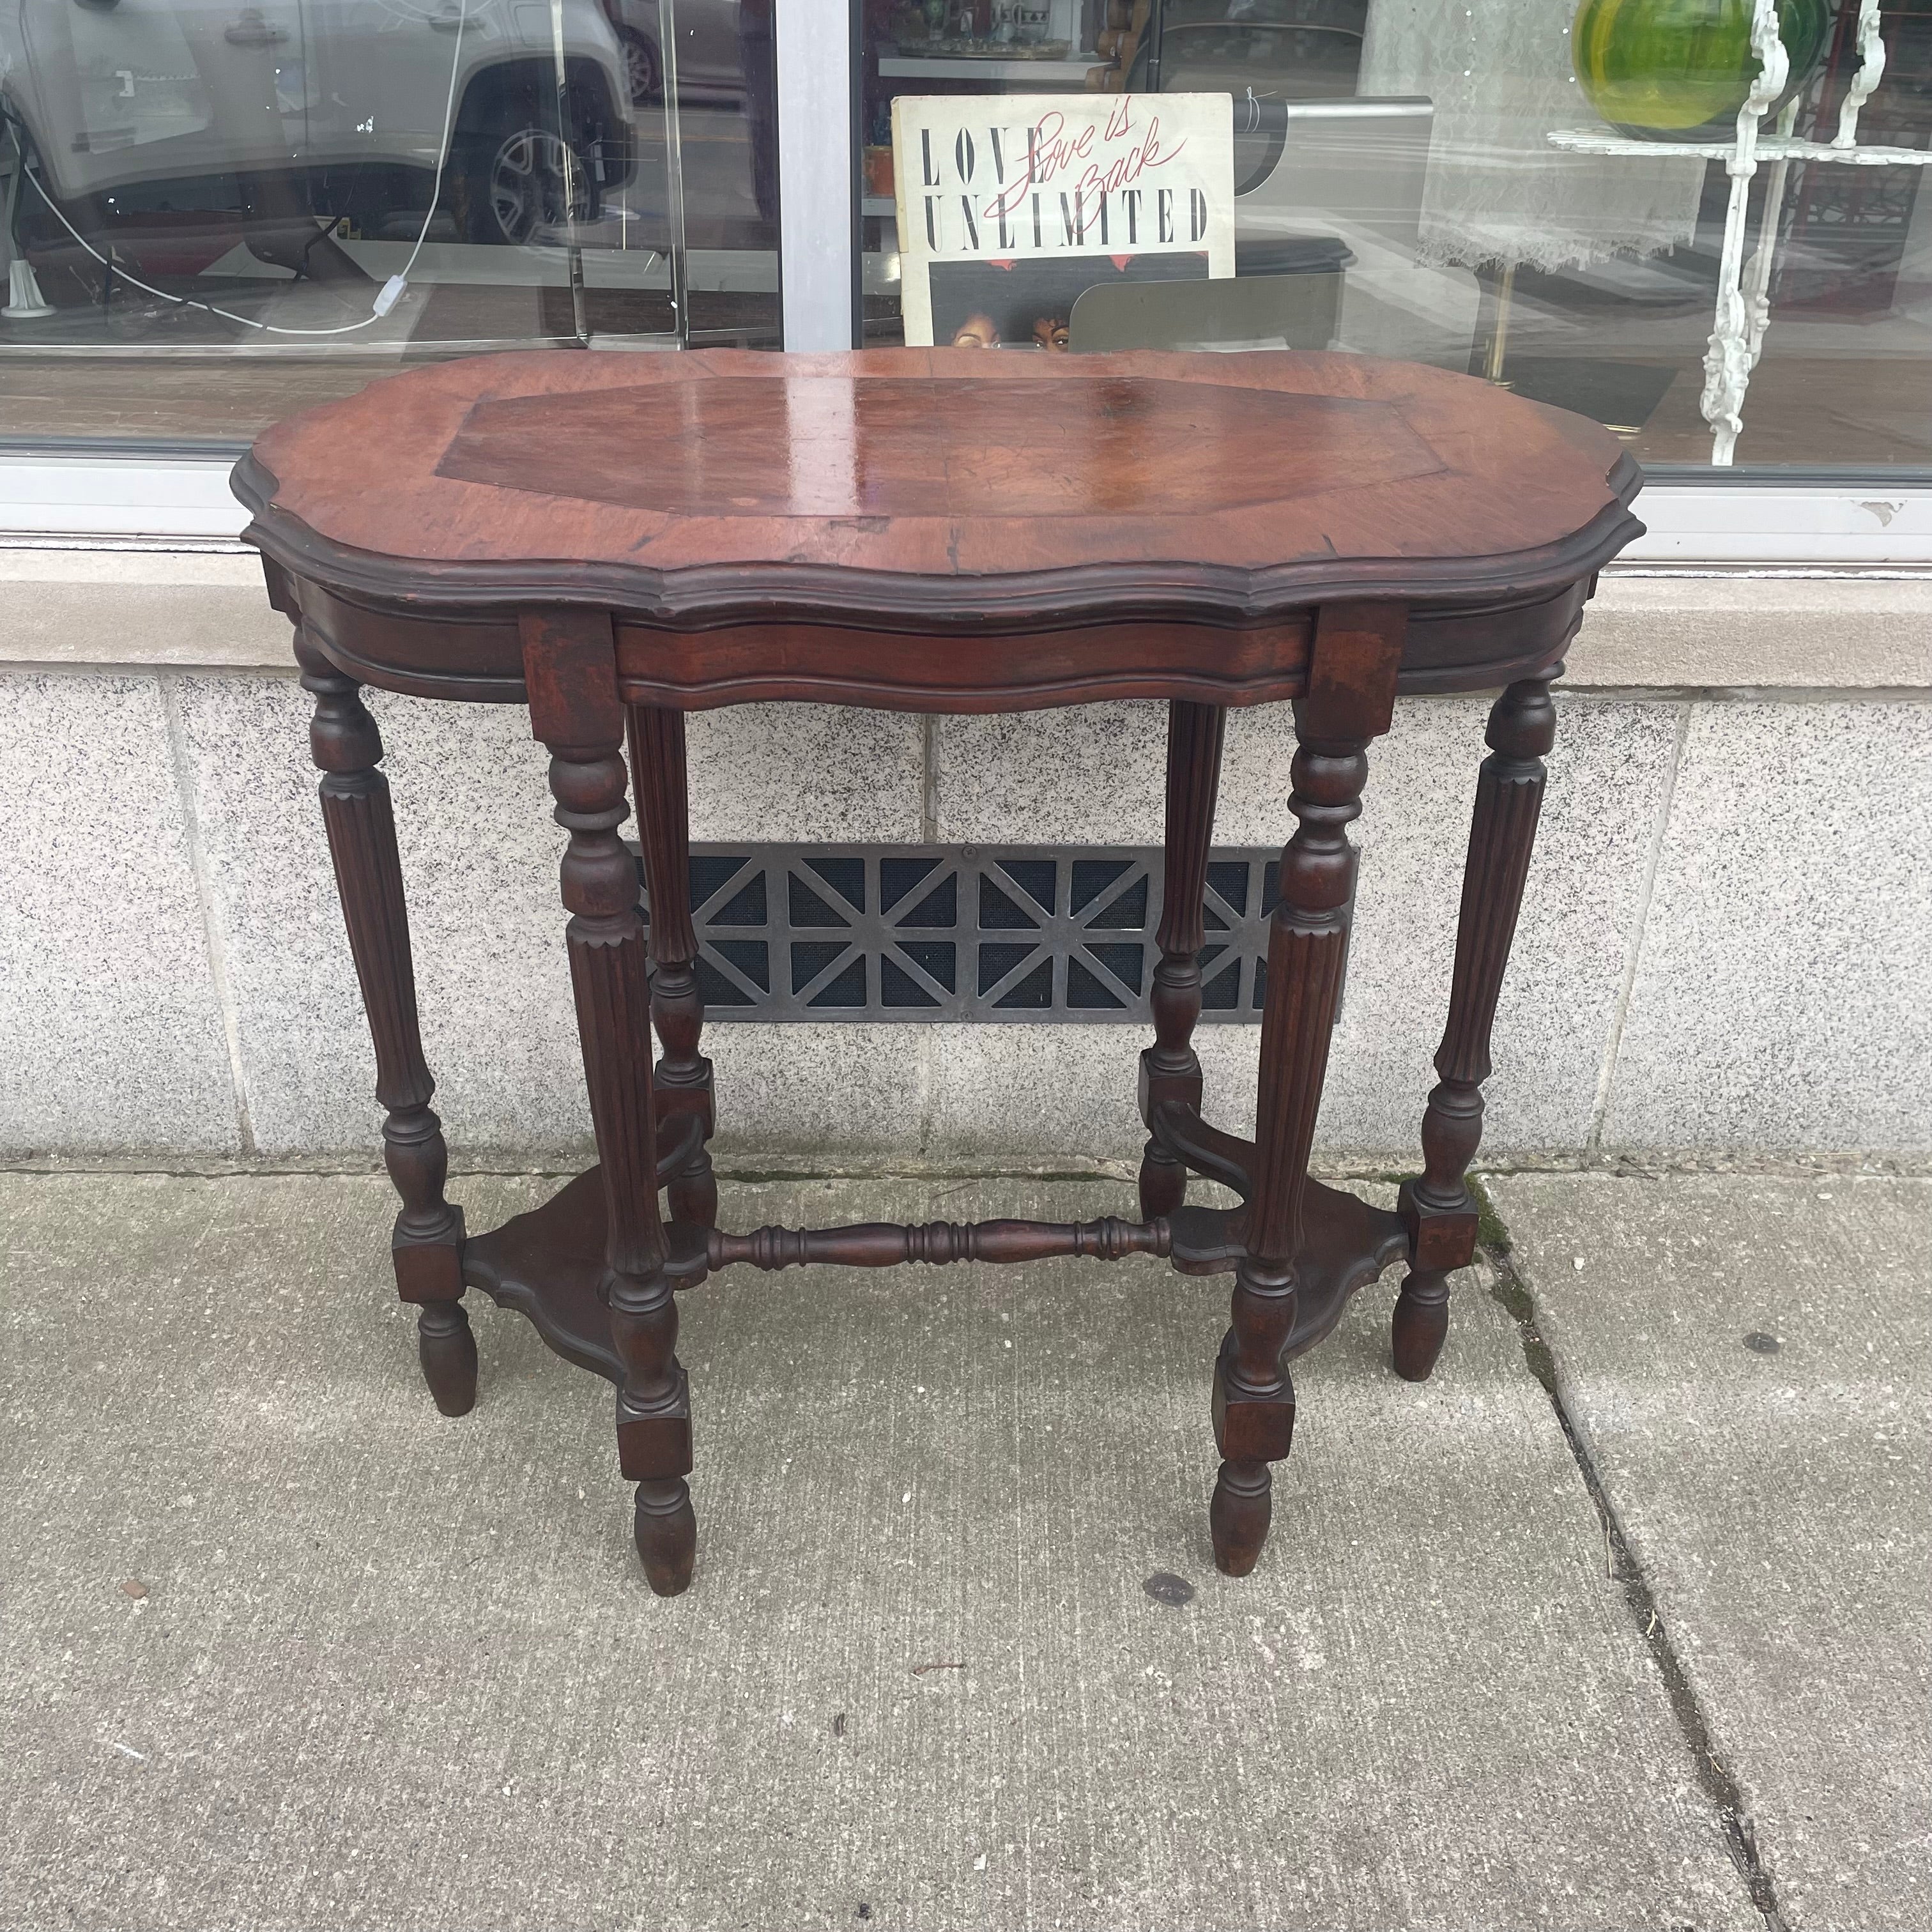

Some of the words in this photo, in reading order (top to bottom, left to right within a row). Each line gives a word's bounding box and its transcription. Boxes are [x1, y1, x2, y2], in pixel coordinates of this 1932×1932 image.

[920, 126, 1045, 186] LOVE
[984, 111, 1095, 217] Love
[1105, 95, 1137, 140] is
[1071, 116, 1188, 234] Back
[923, 187, 1209, 252] UNLIMITED
